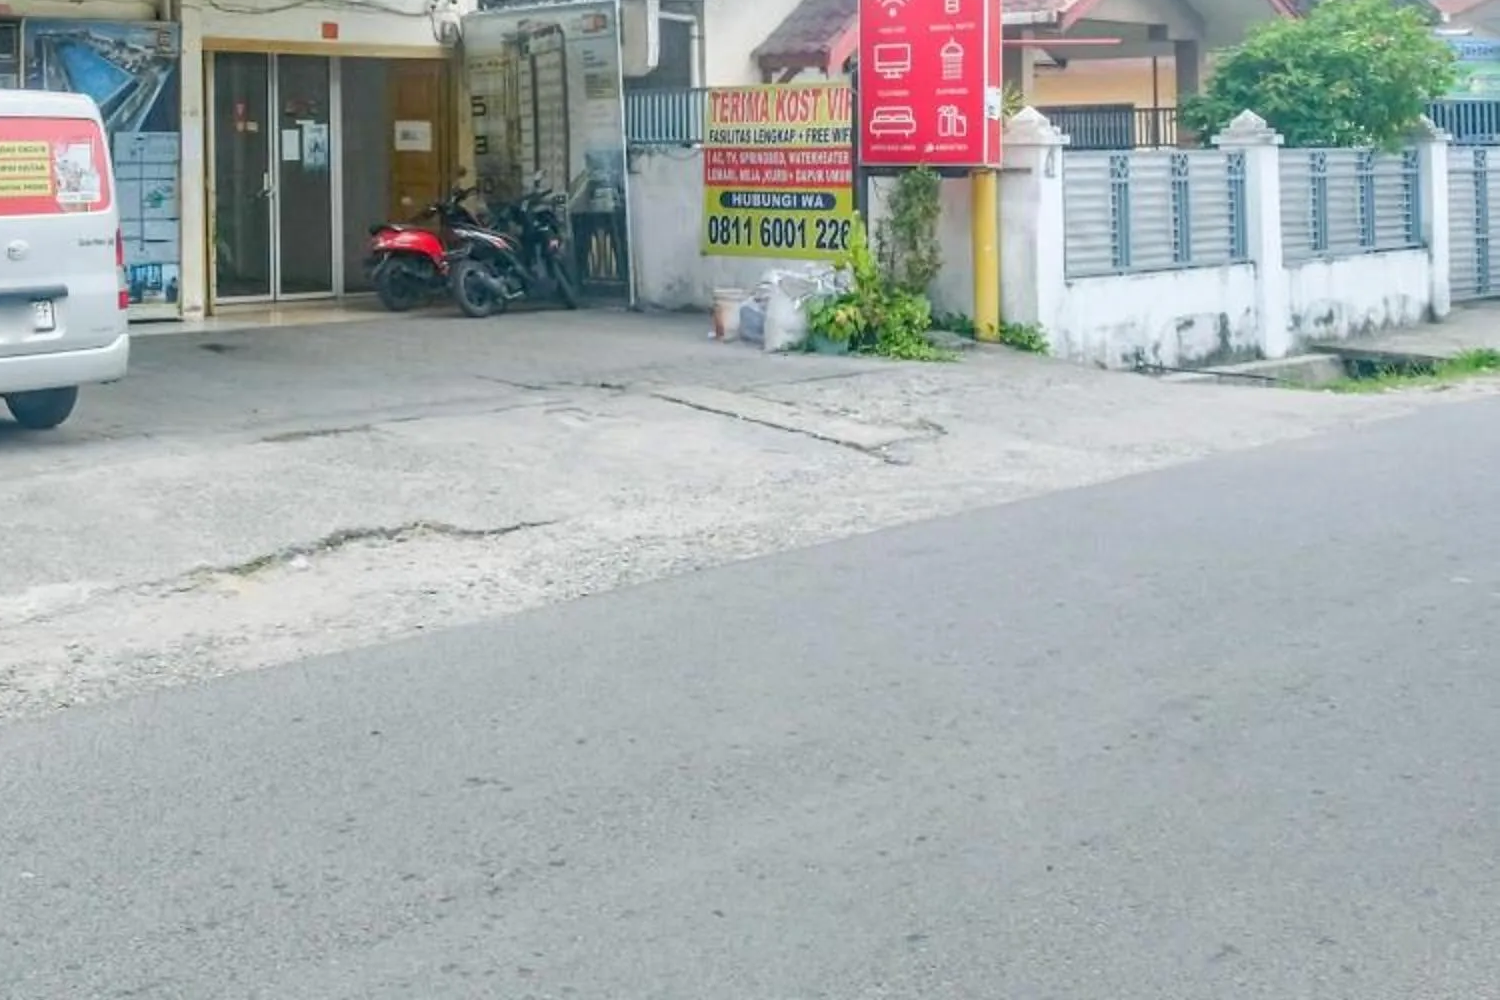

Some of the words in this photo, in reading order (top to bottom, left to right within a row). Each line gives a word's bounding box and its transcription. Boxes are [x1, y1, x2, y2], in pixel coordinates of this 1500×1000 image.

[711, 91, 770, 123] TERIMA
[776, 90, 822, 123] KOST
[709, 129, 751, 143] FASILITAS
[754, 129, 796, 143] LENGKAP
[806, 128, 829, 143] FREE
[731, 193, 797, 207] HUBUNGI
[801, 194, 825, 208] WA
[708, 215, 752, 246] 0811
[760, 217, 807, 249] 6001
